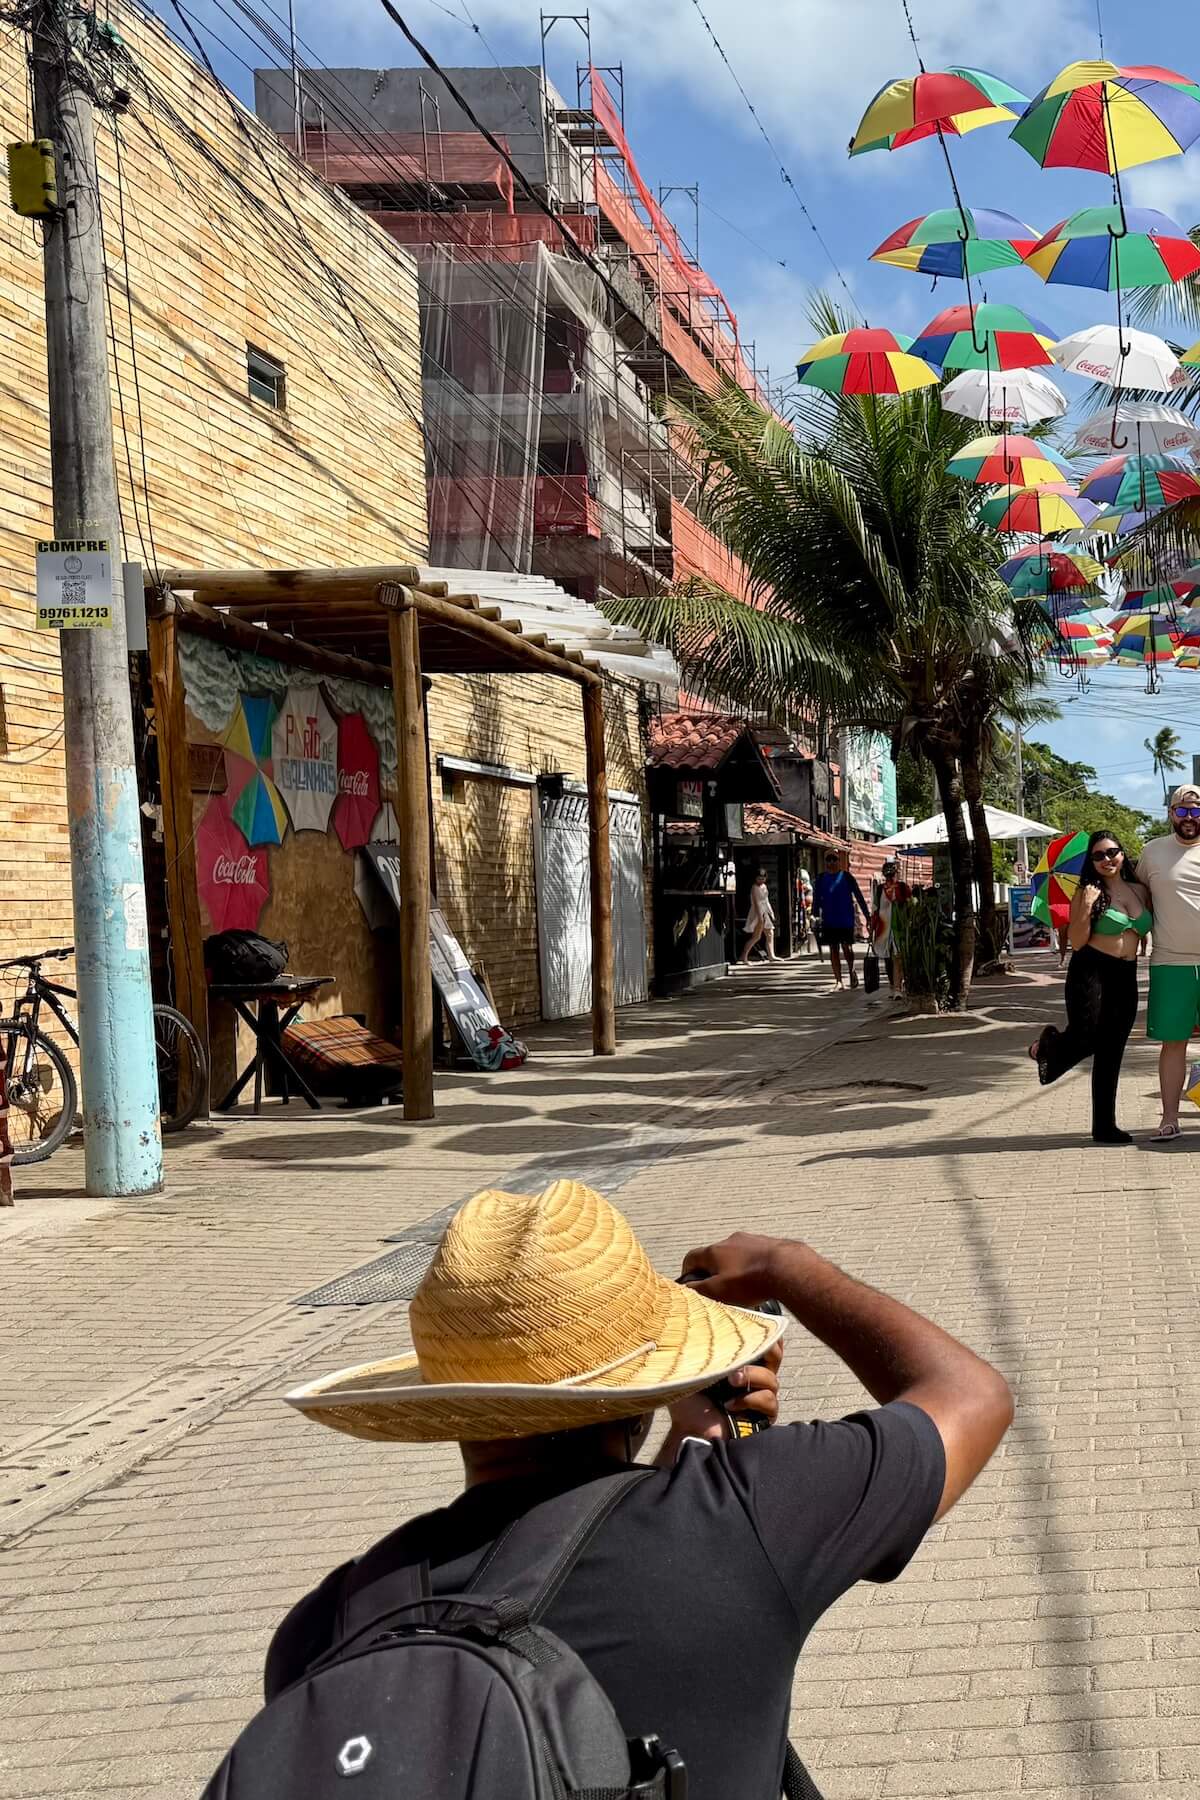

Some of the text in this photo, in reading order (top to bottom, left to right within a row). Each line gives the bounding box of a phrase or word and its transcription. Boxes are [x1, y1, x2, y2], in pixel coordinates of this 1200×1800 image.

[38, 541, 107, 552] COMPRE
[40, 608, 108, 619] 99761.1213
[213, 854, 257, 885] Coca-Cola
